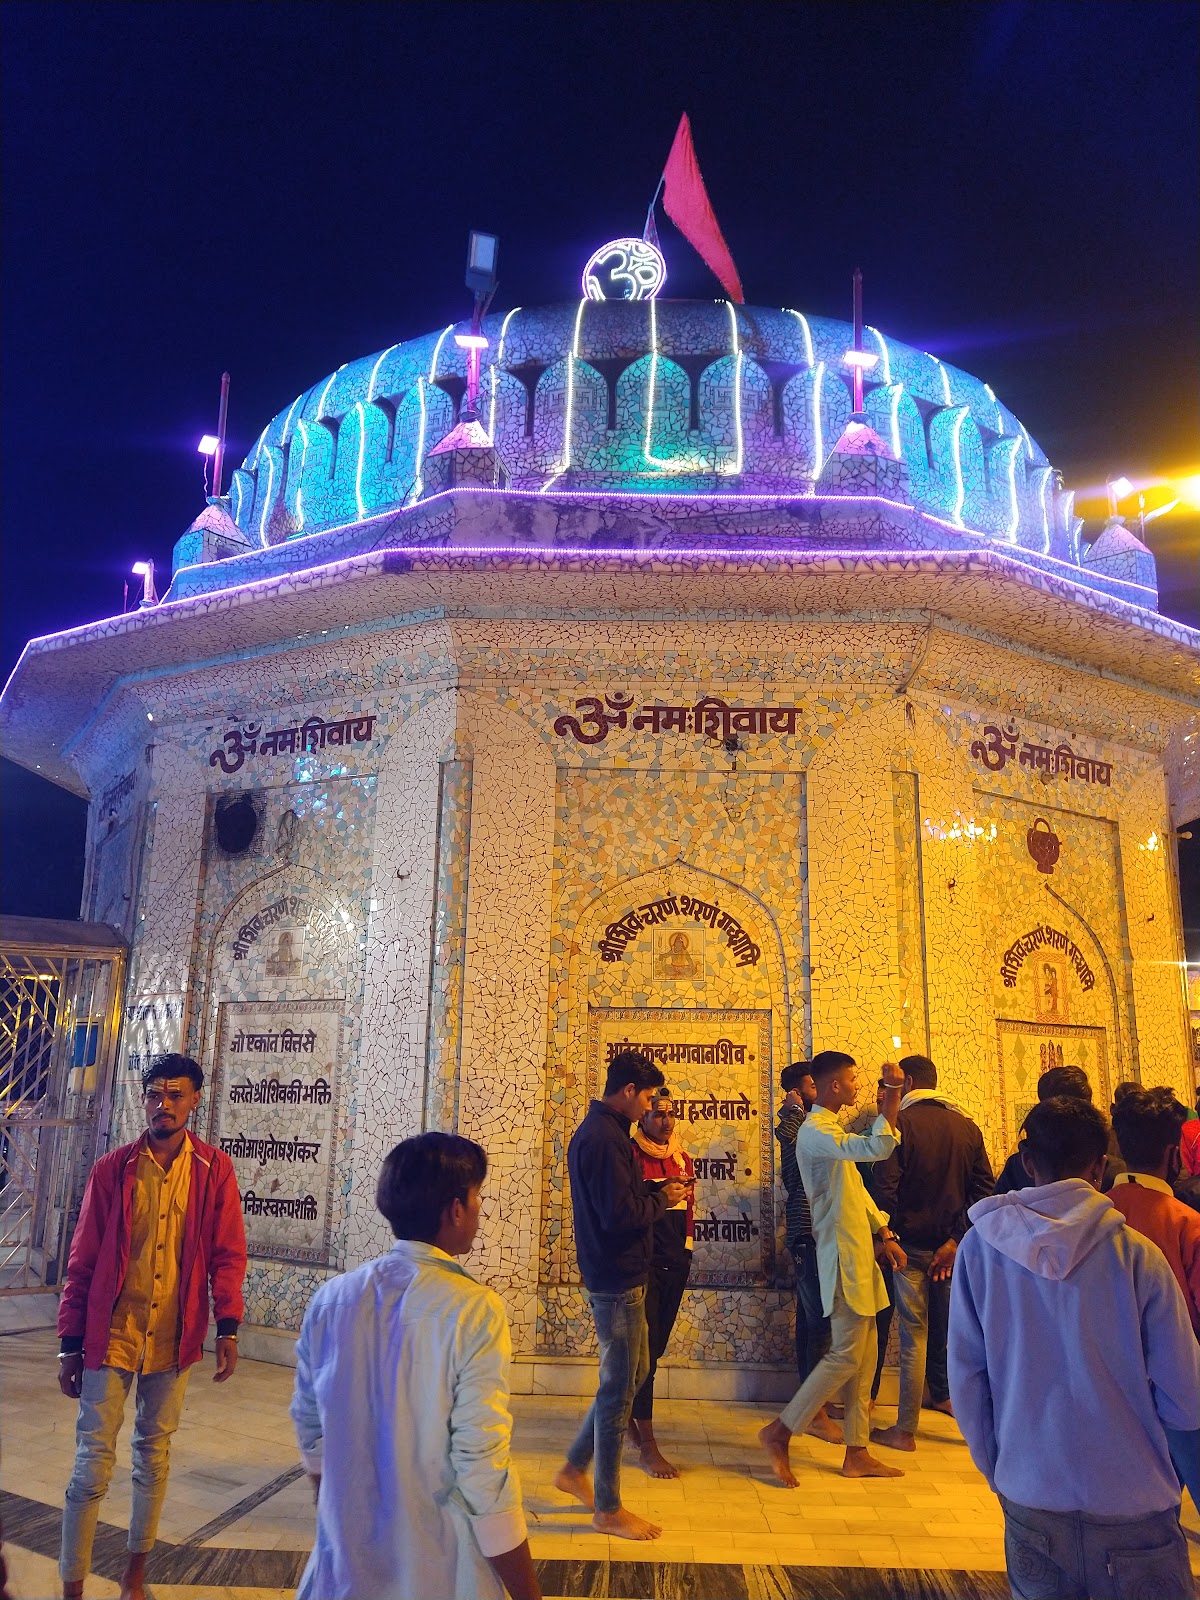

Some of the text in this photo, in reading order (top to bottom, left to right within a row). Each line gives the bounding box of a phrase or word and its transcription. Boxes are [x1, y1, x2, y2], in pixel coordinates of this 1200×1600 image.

[554, 692, 635, 744] ॐ
[209, 723, 262, 774] ॐ
[971, 725, 1020, 771] ॐ
